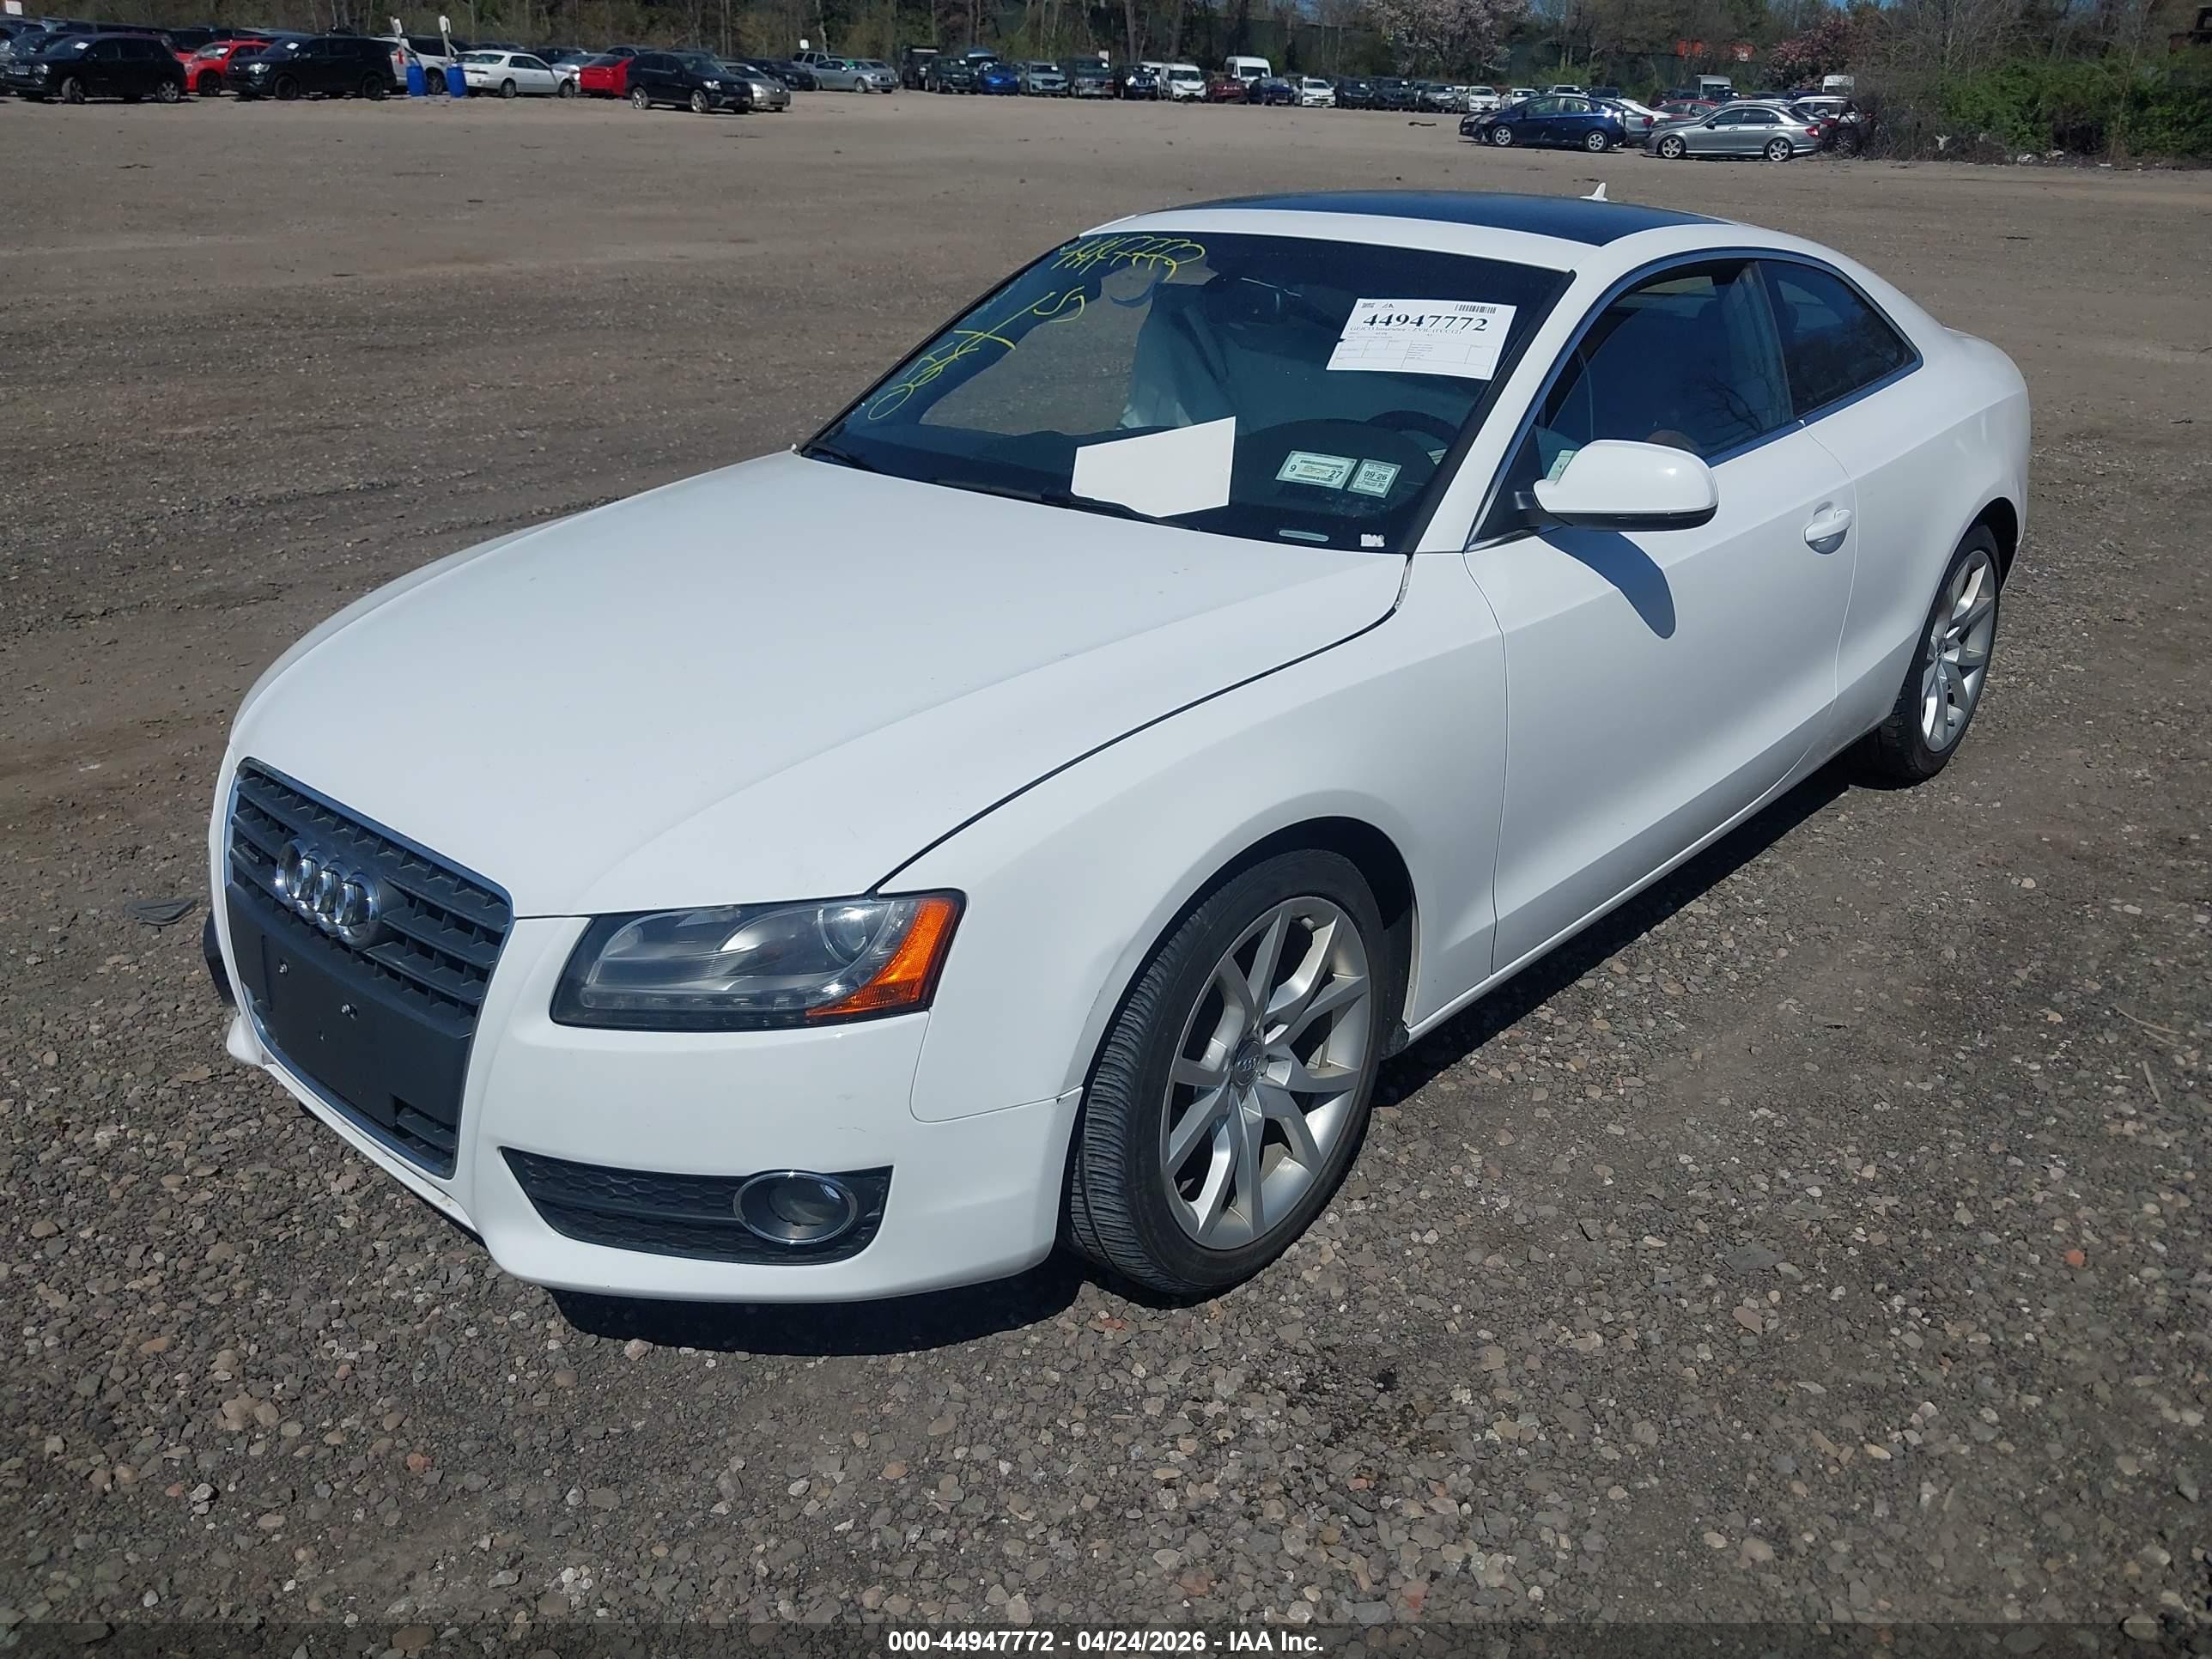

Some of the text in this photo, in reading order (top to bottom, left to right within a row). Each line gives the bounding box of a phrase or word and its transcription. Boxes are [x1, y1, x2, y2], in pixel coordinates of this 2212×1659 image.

[1363, 313, 1489, 332] 44947772
[1289, 464, 1297, 473] 9
[1328, 470, 1344, 479] 27
